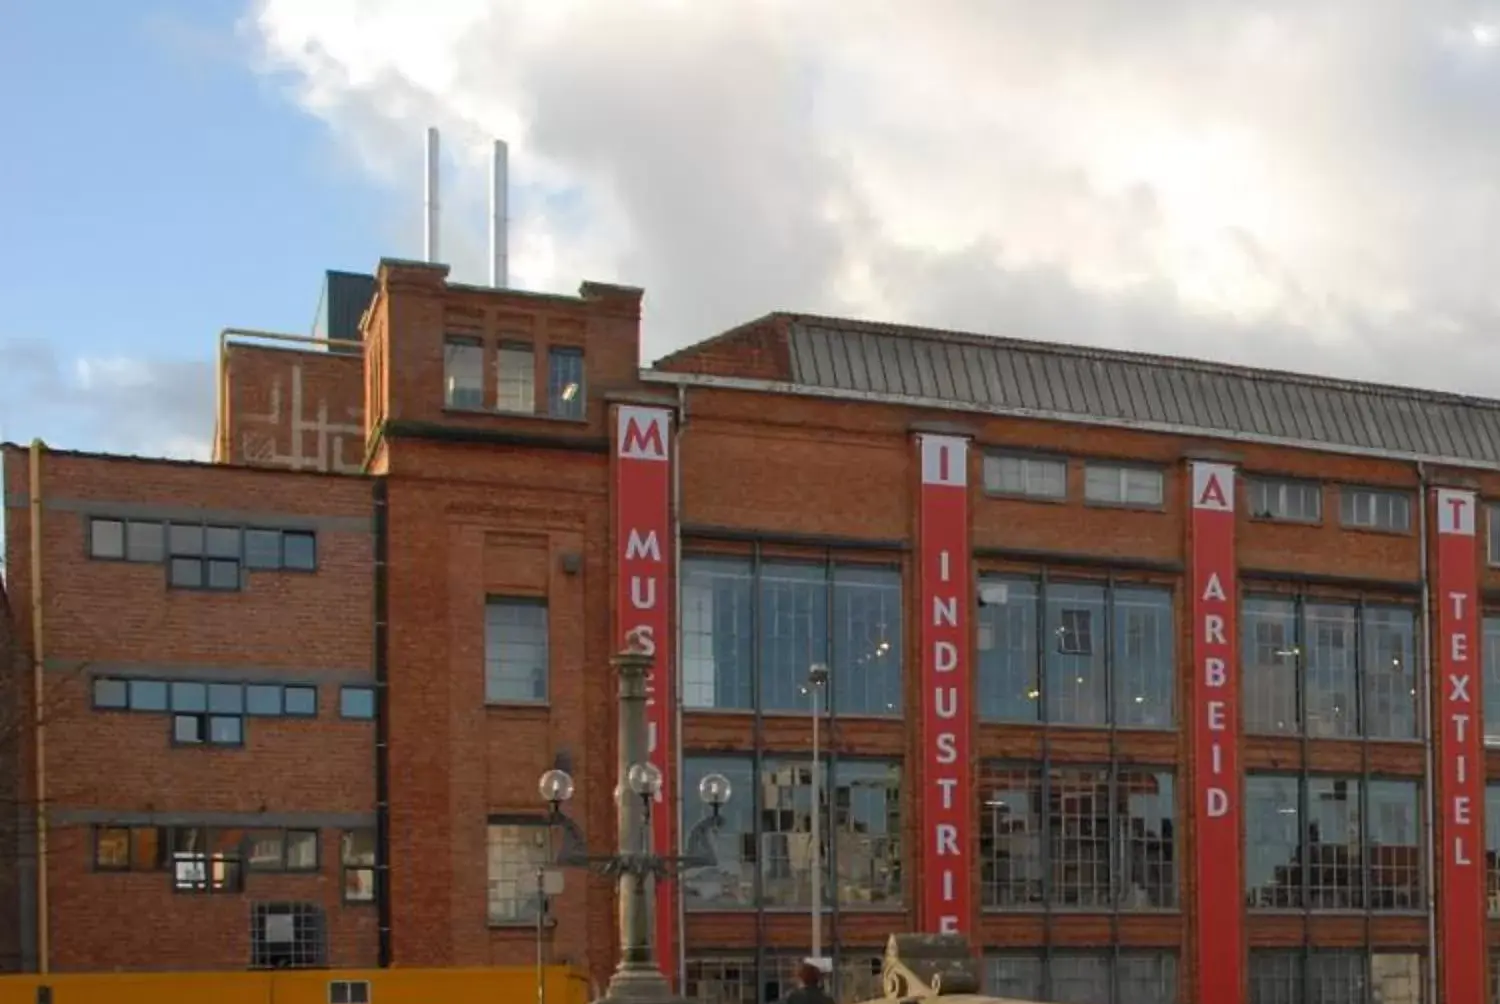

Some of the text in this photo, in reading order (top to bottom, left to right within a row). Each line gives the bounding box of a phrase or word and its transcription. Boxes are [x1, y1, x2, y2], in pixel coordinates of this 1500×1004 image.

[622, 416, 664, 456] M
[939, 445, 949, 480] I
[1201, 473, 1227, 507] A
[1449, 496, 1466, 530] T
[1203, 572, 1229, 818] ARBEID
[1449, 592, 1471, 865] TEXTIEL
